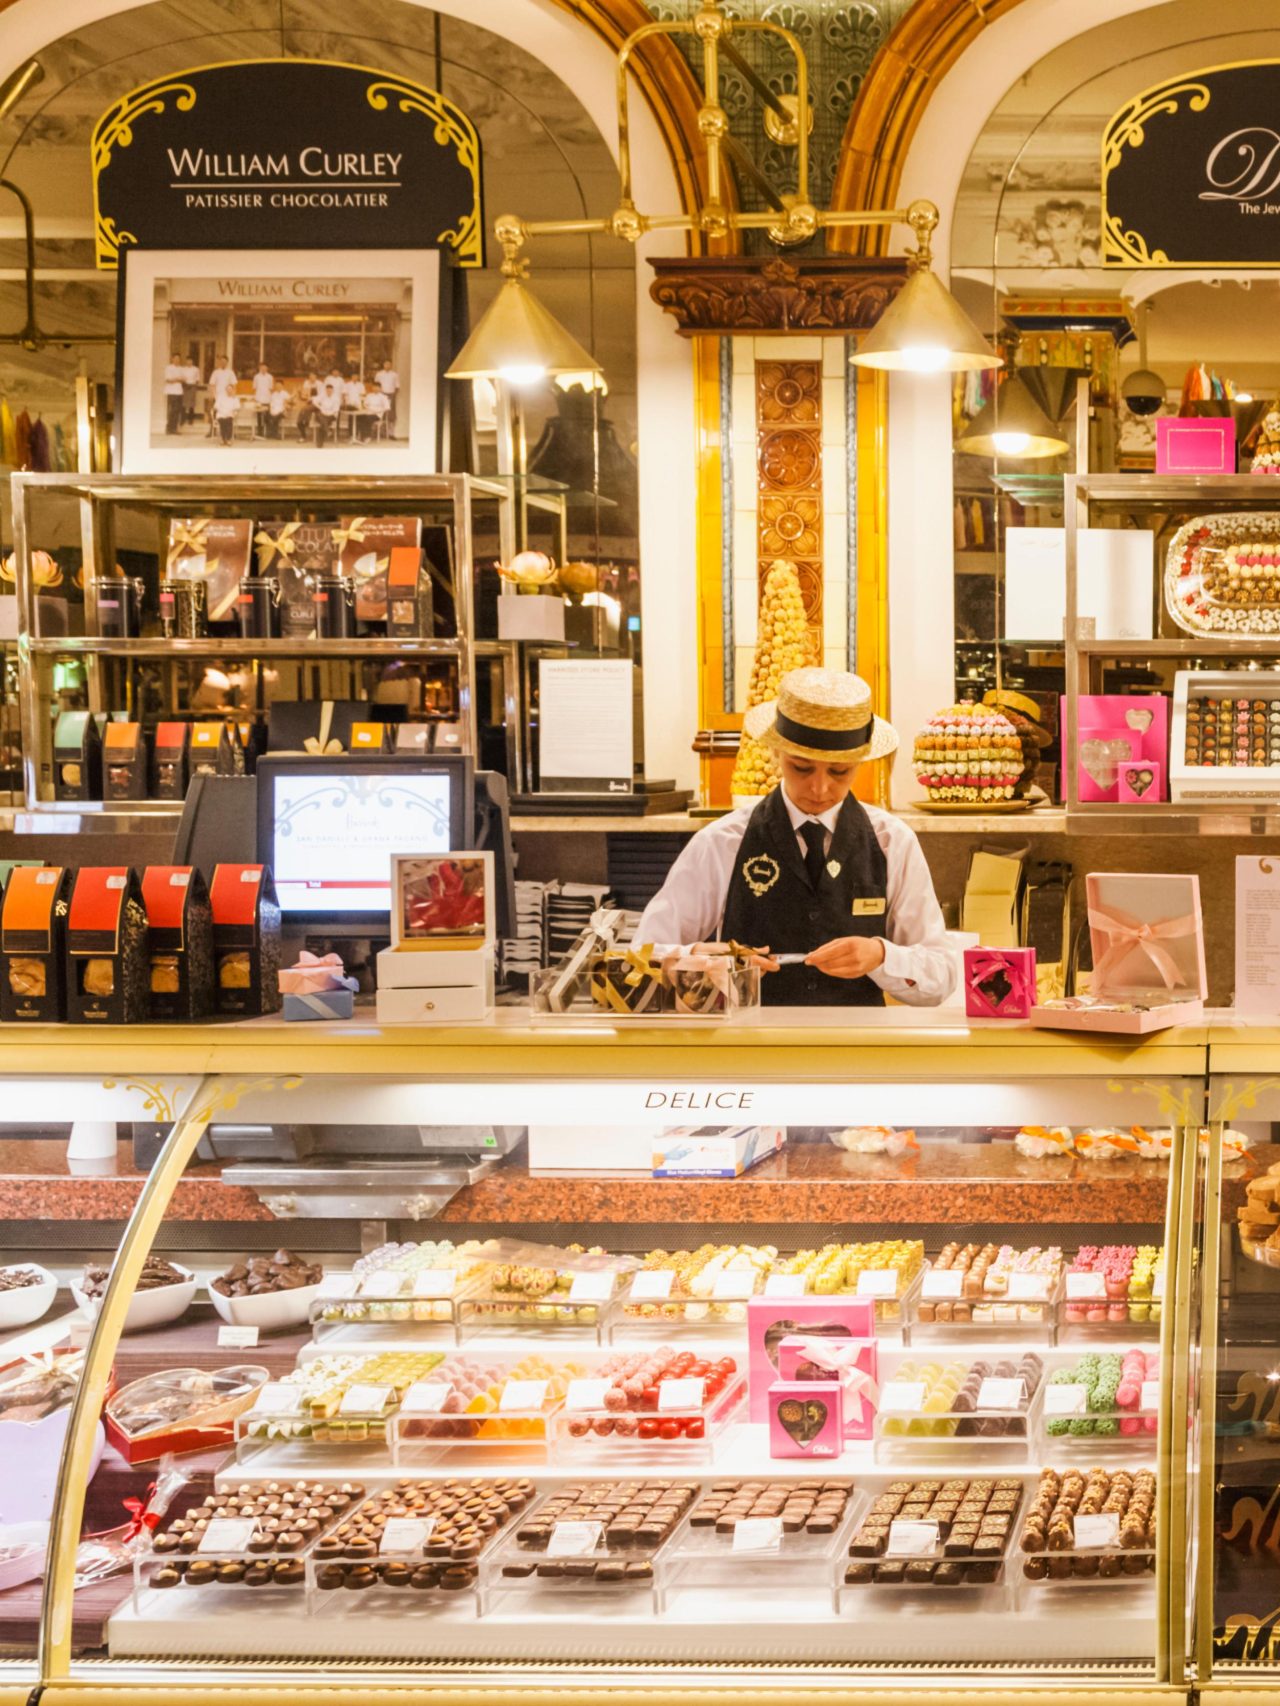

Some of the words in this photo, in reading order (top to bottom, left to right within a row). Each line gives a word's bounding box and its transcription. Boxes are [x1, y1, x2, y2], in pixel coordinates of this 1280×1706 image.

[167, 147, 289, 176] WILLIAM
[299, 146, 402, 176] CURLEY
[185, 193, 263, 208] PATISSIER
[270, 193, 389, 208] CHOCOLATIER
[1239, 202, 1260, 214] The
[217, 280, 283, 296] WILLIAM
[291, 280, 350, 297] CURLEY
[645, 1092, 754, 1109] DELICE
